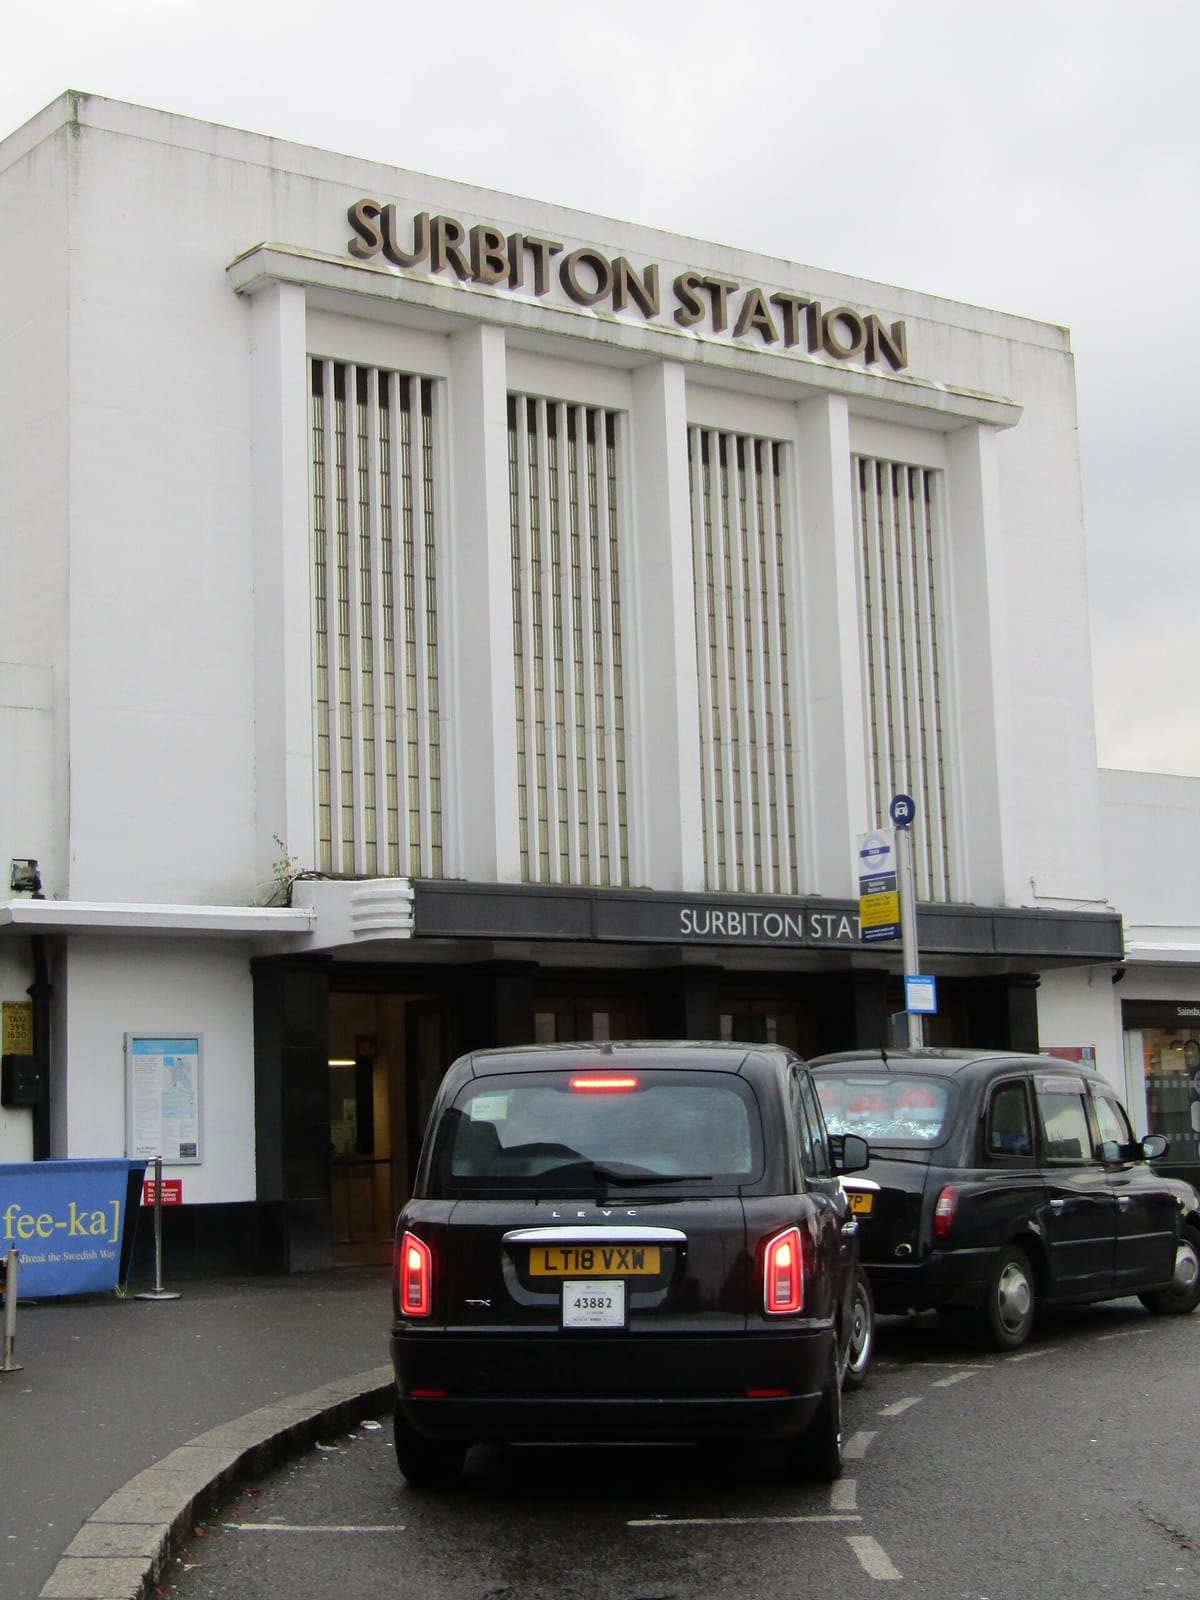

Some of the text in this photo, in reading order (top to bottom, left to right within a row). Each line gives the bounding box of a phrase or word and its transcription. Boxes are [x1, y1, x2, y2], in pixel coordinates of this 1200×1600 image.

[347, 198, 907, 371] SURBITON STATION
[680, 909, 802, 938] SURBITON
[810, 914, 862, 939] STAT
[1176, 1006, 1200, 1017] Sainsb
[552, 1209, 637, 1218] LEVC
[48, 1252, 61, 1262] the
[63, 1250, 97, 1262] Swedish
[99, 1248, 116, 1260] Way
[544, 1249, 645, 1271] LT18 VXW
[573, 1297, 613, 1309] 43882
